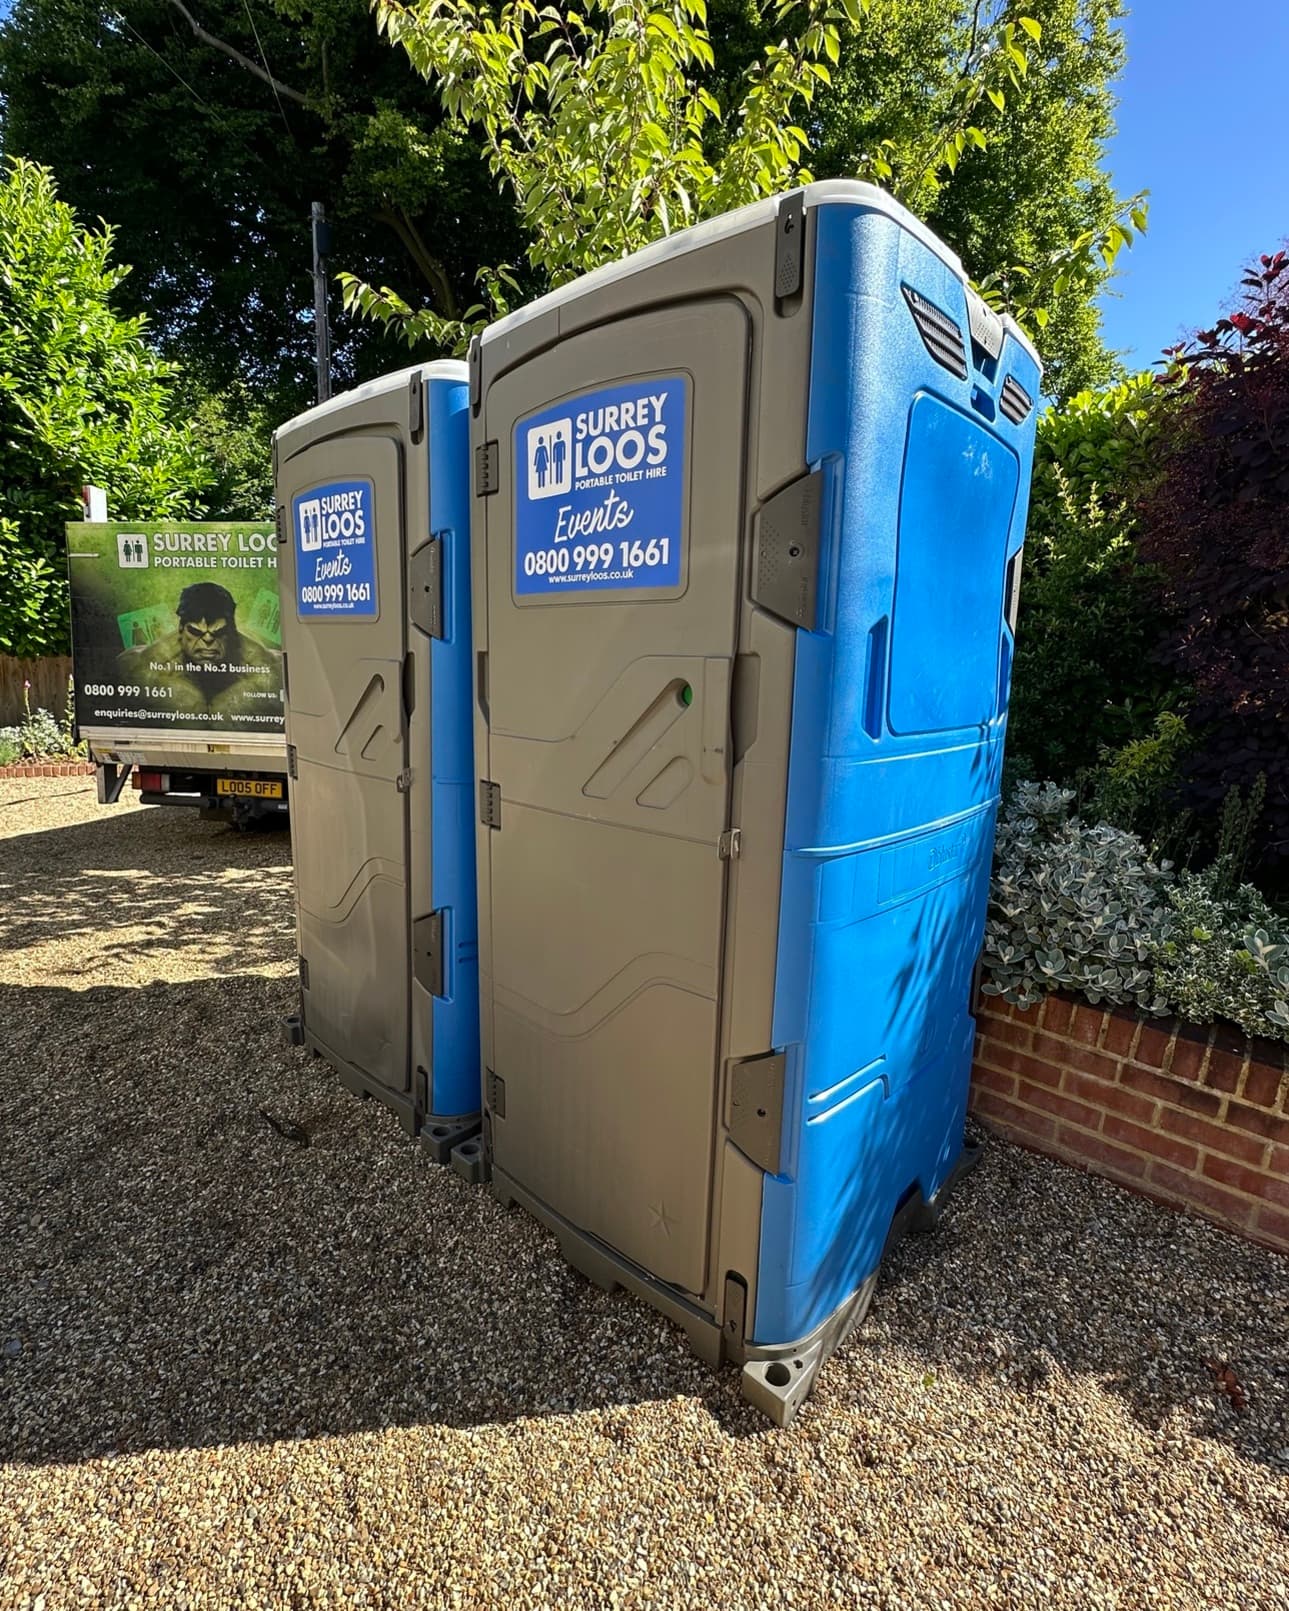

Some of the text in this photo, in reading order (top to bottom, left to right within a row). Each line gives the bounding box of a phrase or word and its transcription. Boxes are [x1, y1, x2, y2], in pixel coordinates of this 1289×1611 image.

[576, 392, 668, 440] SURREY
[575, 424, 668, 478] LOOS
[575, 466, 667, 491] PORTABLE TOILET HIRE
[321, 490, 363, 514] SURREY
[322, 509, 365, 540] LOOS
[554, 488, 634, 543] Events
[153, 533, 231, 552] SURREY
[154, 556, 217, 569] PORTABLE
[220, 556, 264, 568] TOILET
[314, 548, 353, 582] Events
[524, 537, 669, 576] 0800 999 1661
[548, 568, 634, 583] www.surreyloos.co.uk
[301, 582, 370, 603] 0800 999 1661
[149, 661, 271, 674] No.1 in the No.2 business
[84, 684, 173, 698] 0800 999 1661
[94, 707, 224, 722] enquiries@surreyloos.co.uk
